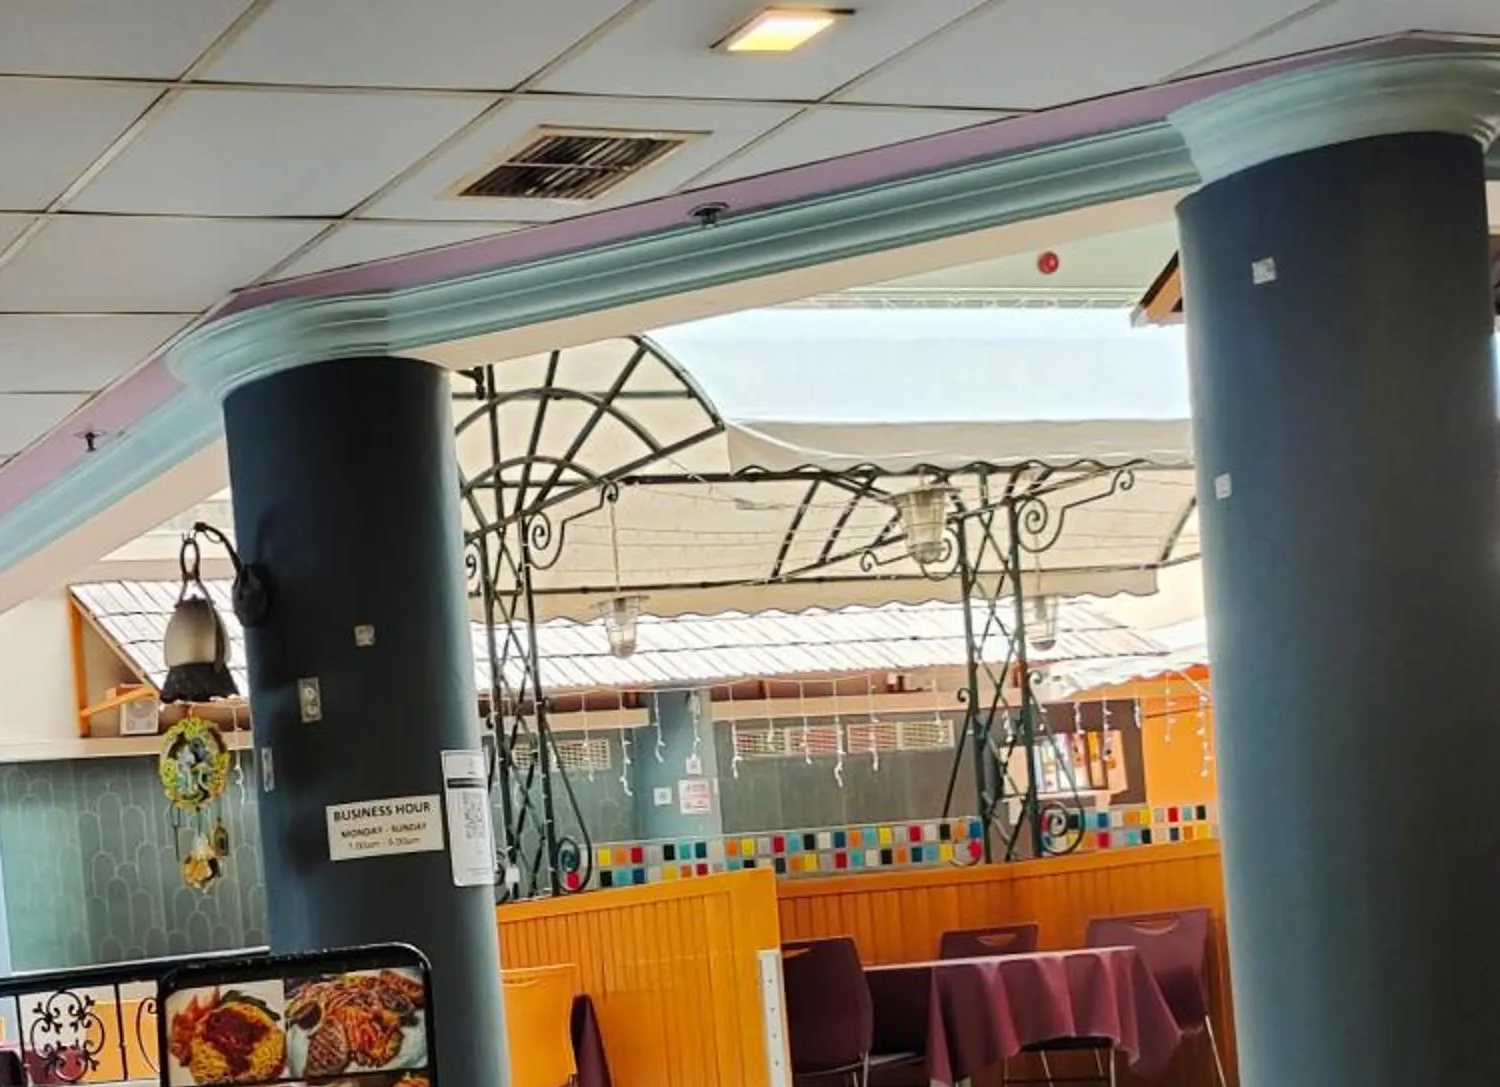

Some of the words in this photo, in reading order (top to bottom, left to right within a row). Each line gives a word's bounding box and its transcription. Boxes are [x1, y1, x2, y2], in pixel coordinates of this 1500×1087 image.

[333, 805, 393, 821] BUSINESS
[395, 802, 431, 814] HOUR
[341, 826, 383, 838] MONDAY
[391, 823, 427, 833] SUNDAY
